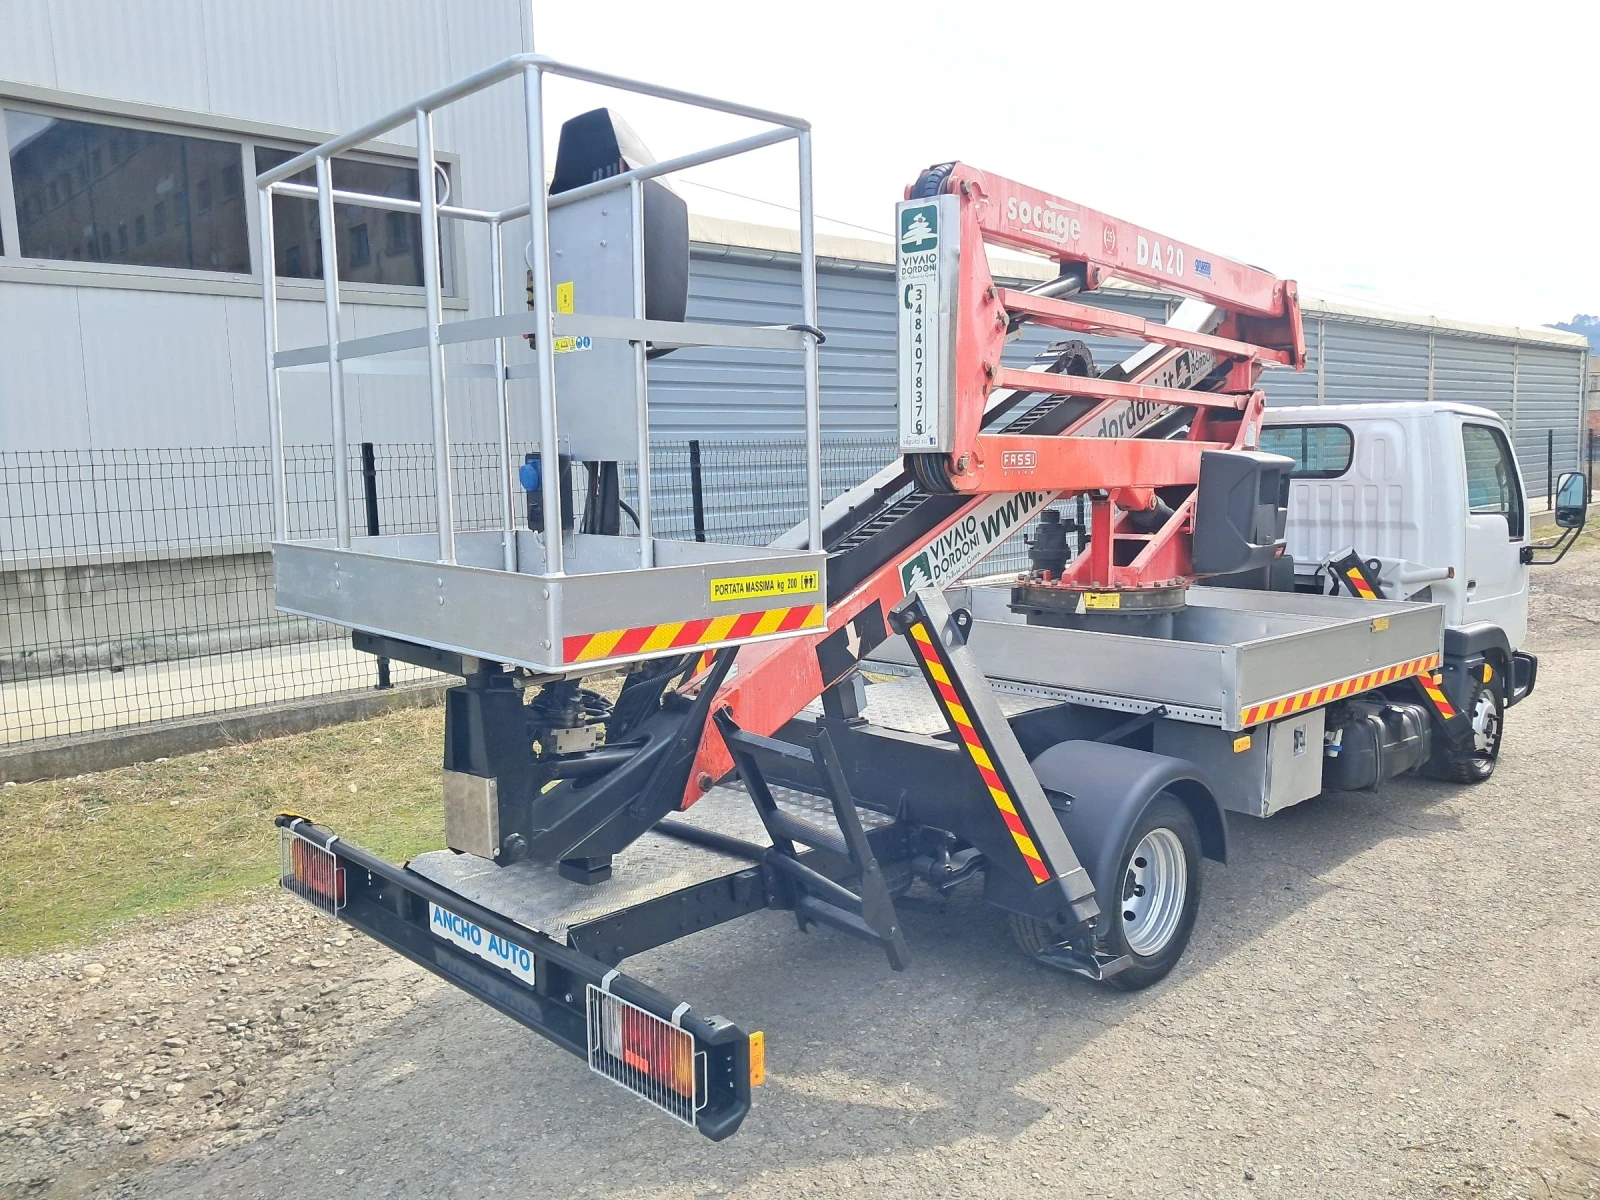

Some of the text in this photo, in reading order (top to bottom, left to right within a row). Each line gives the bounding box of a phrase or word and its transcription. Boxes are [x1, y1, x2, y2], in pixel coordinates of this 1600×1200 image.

[1007, 197, 1081, 243] socage
[902, 253, 937, 266] VIVAIO
[902, 263, 937, 275] DORDONI
[1137, 235, 1163, 271] DA
[1166, 245, 1184, 277] 20
[915, 289, 923, 431] 3484078376
[1003, 453, 1035, 466] FASSI
[930, 515, 977, 561] VIVAIO
[933, 532, 980, 580] DORDONI
[714, 578, 798, 596] PORTATA MASSIMA kg 200
[433, 905, 531, 972] ANCHO AUTO
